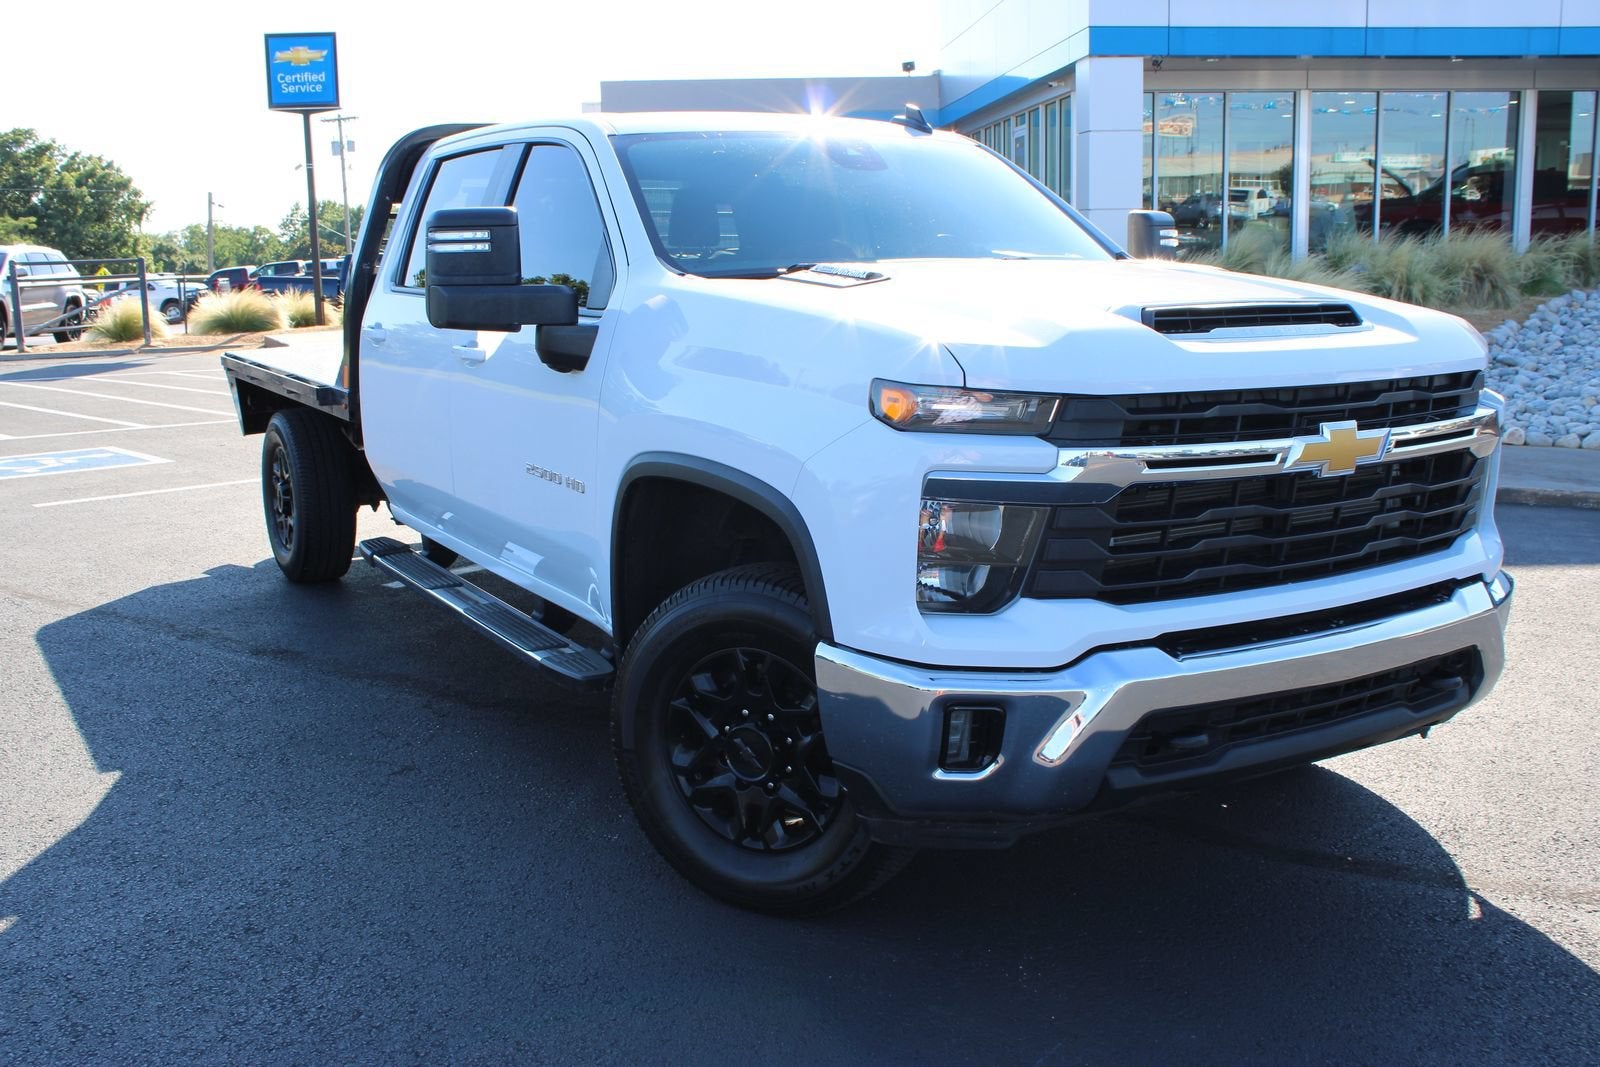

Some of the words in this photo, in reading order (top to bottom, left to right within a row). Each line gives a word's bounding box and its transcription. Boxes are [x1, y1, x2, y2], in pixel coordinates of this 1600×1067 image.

[277, 72, 326, 83] Certified
[281, 83, 323, 93] Service
[525, 462, 562, 485] 2500
[565, 475, 585, 494] HD
